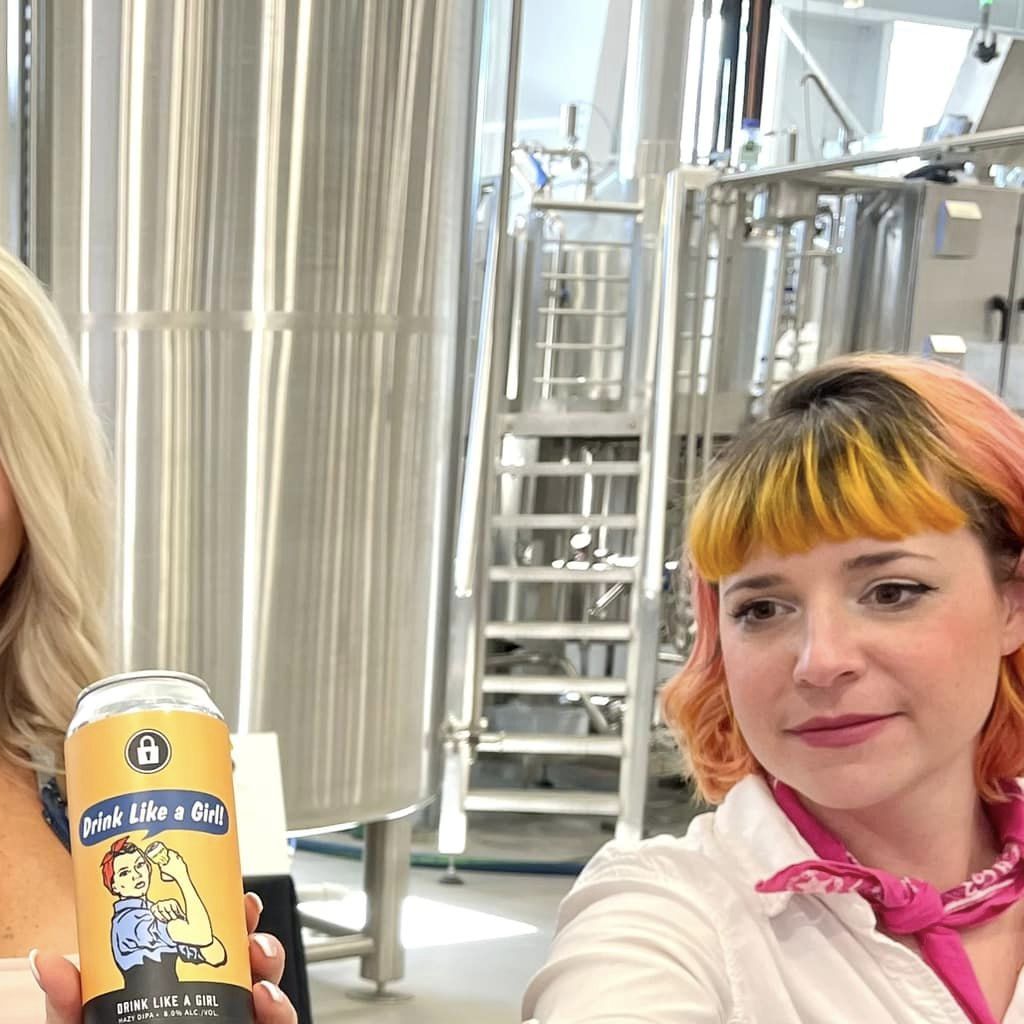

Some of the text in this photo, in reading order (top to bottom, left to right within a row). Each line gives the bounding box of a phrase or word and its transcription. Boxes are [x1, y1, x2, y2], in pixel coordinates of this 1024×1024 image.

[83, 800, 225, 839] Drink Like a Girl!
[116, 994, 219, 1015] DRINK LIKE A GIRL
[137, 1012, 154, 1021] DIPA
